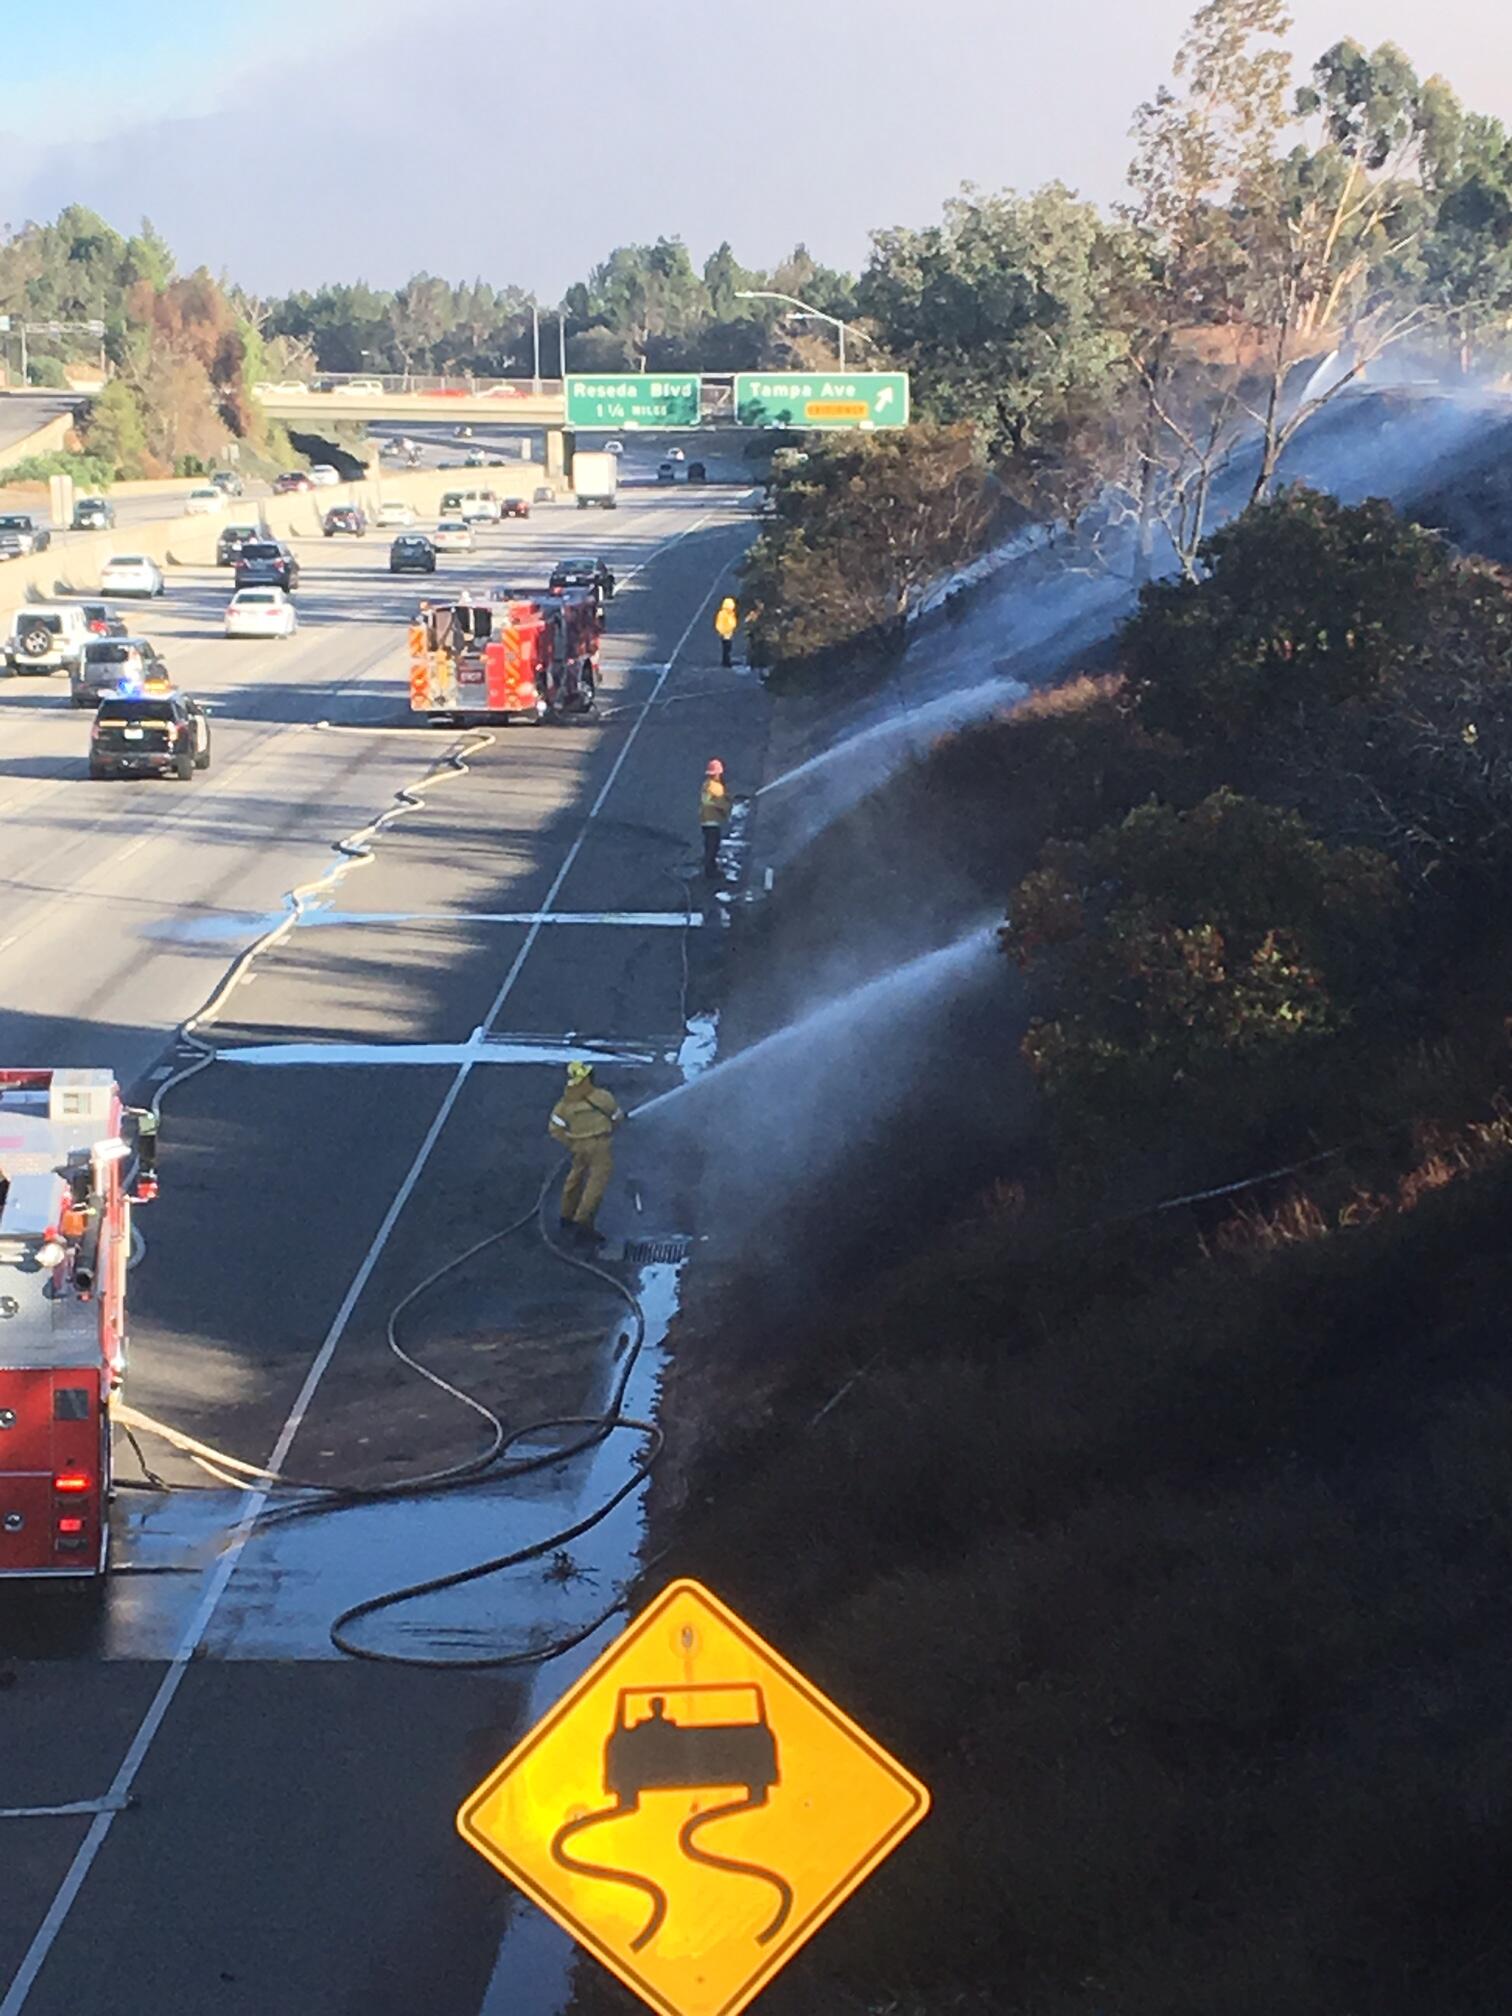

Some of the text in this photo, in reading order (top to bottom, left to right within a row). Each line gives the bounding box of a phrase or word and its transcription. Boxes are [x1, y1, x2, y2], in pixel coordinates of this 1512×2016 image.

[573, 383, 692, 398] Reseda Blvd
[750, 382, 856, 399] Tampa Ave
[596, 403, 604, 418] 1
